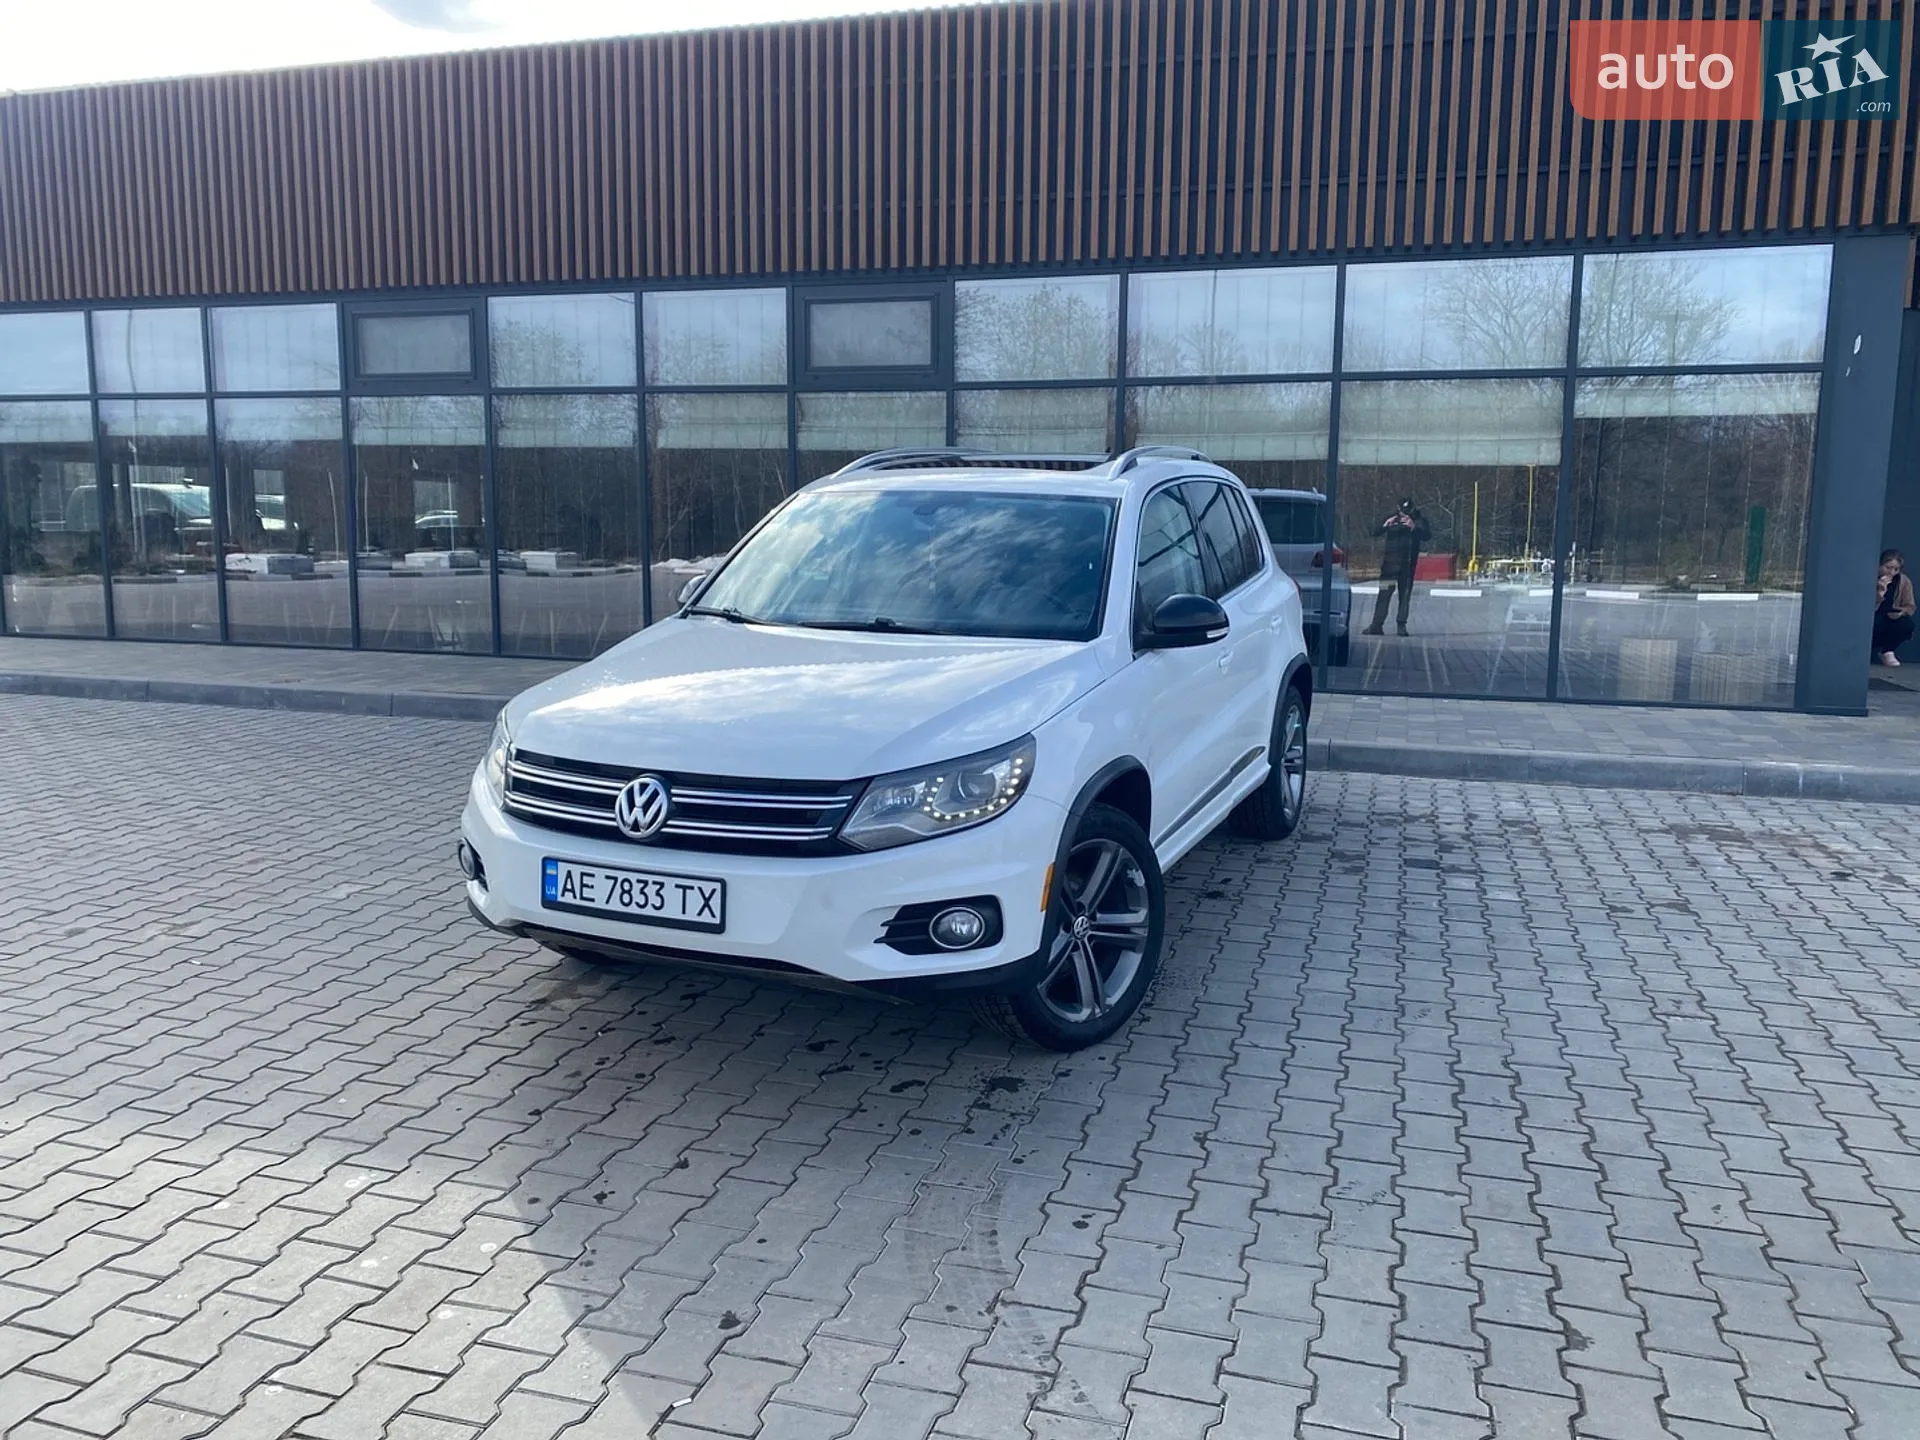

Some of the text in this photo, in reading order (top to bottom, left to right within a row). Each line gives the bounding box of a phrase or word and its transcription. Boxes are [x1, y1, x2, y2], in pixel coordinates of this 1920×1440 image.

[560, 869, 717, 919] AE 7833 TX
